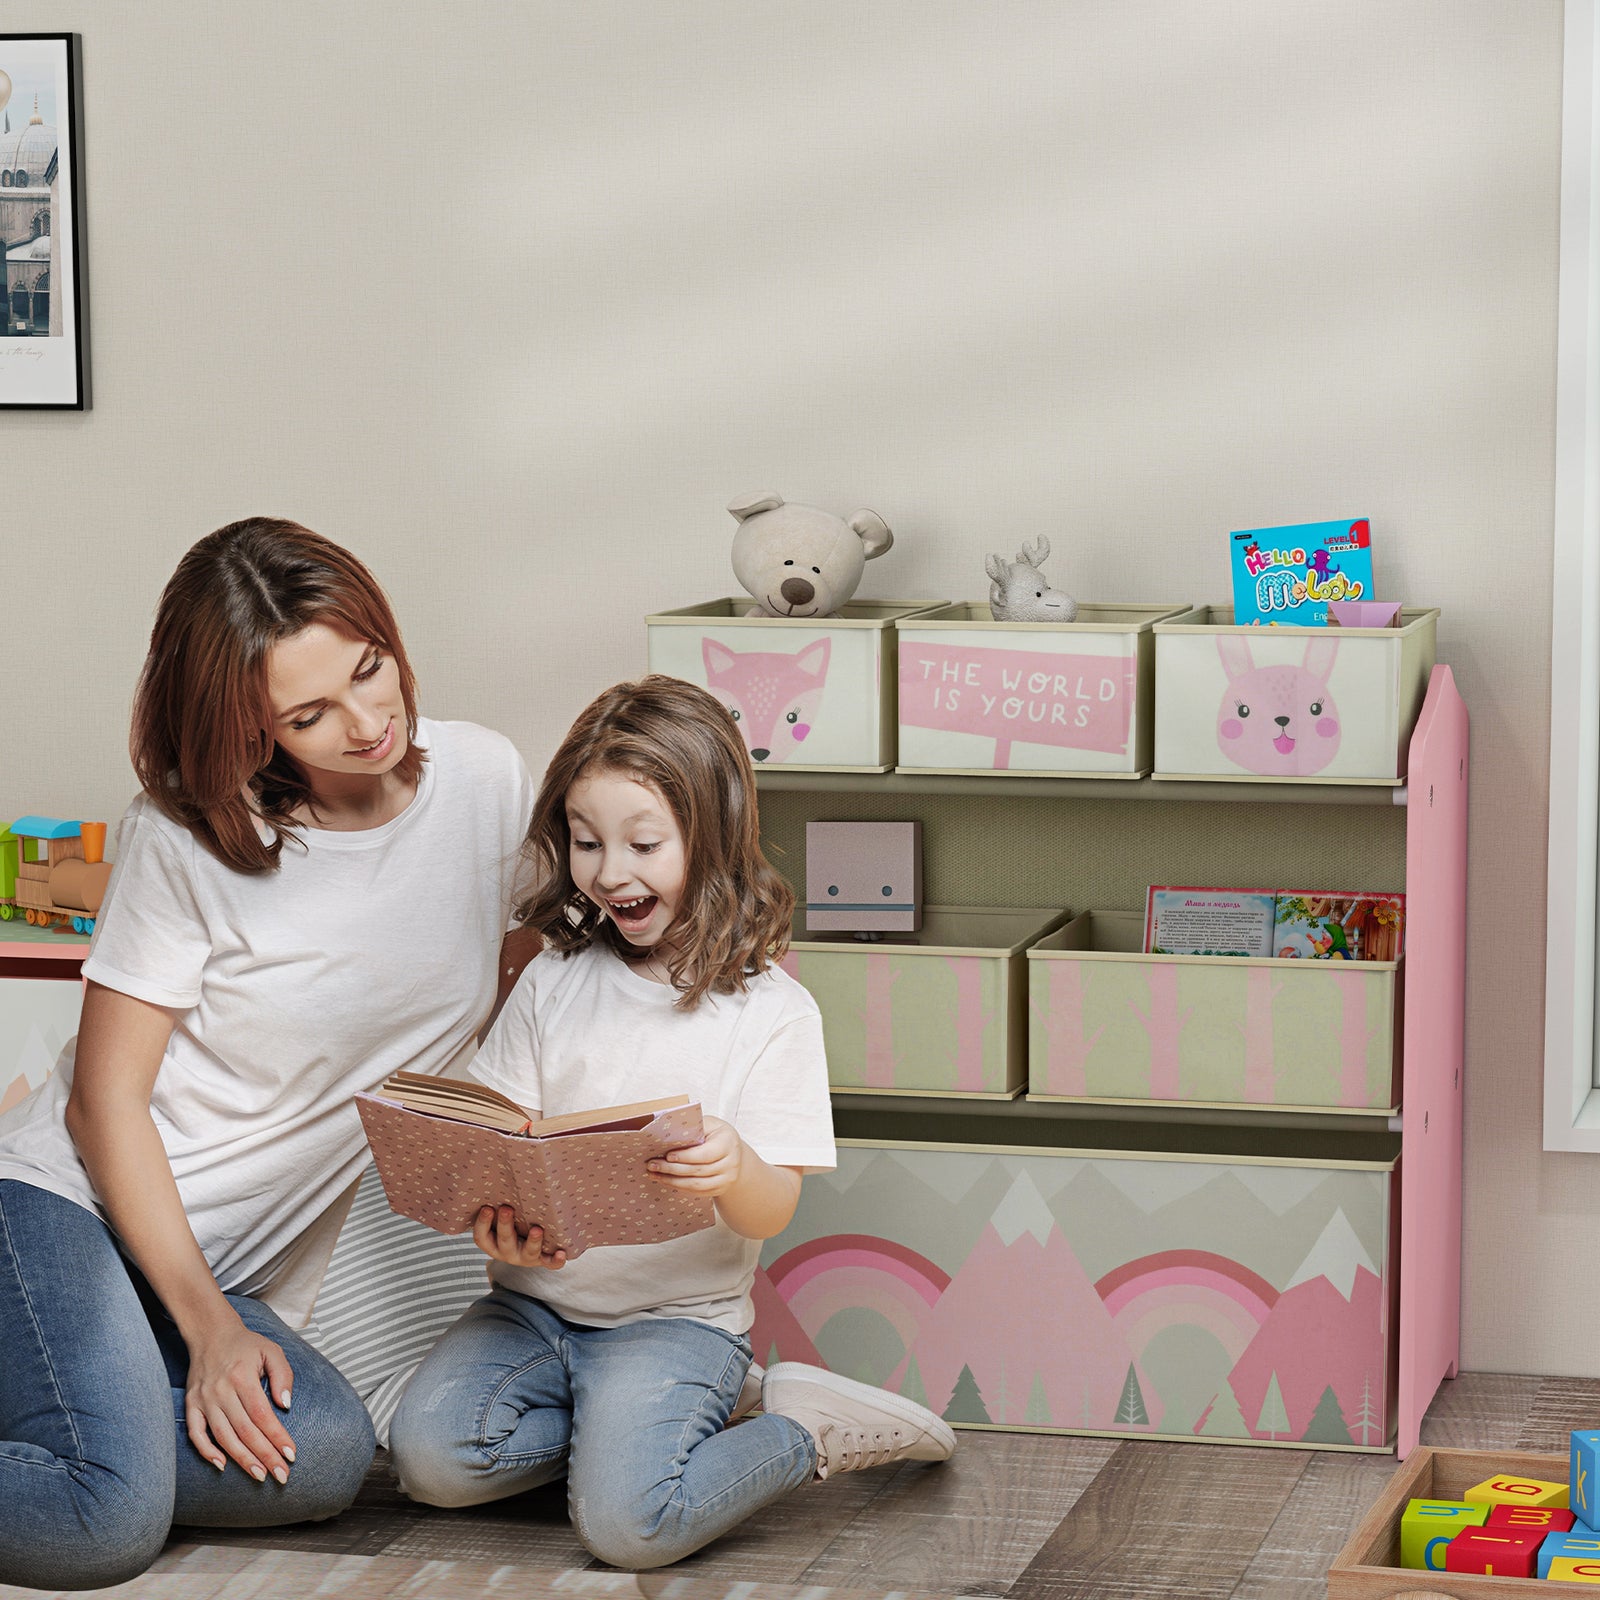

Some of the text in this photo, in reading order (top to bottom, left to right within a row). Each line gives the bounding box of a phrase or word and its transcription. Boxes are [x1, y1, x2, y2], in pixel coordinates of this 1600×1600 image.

[1323, 529, 1359, 545] LEVEL 1
[1246, 548, 1305, 576] HELLO
[919, 659, 1116, 702] THE WORLD
[933, 687, 1091, 727] IS YOURS
